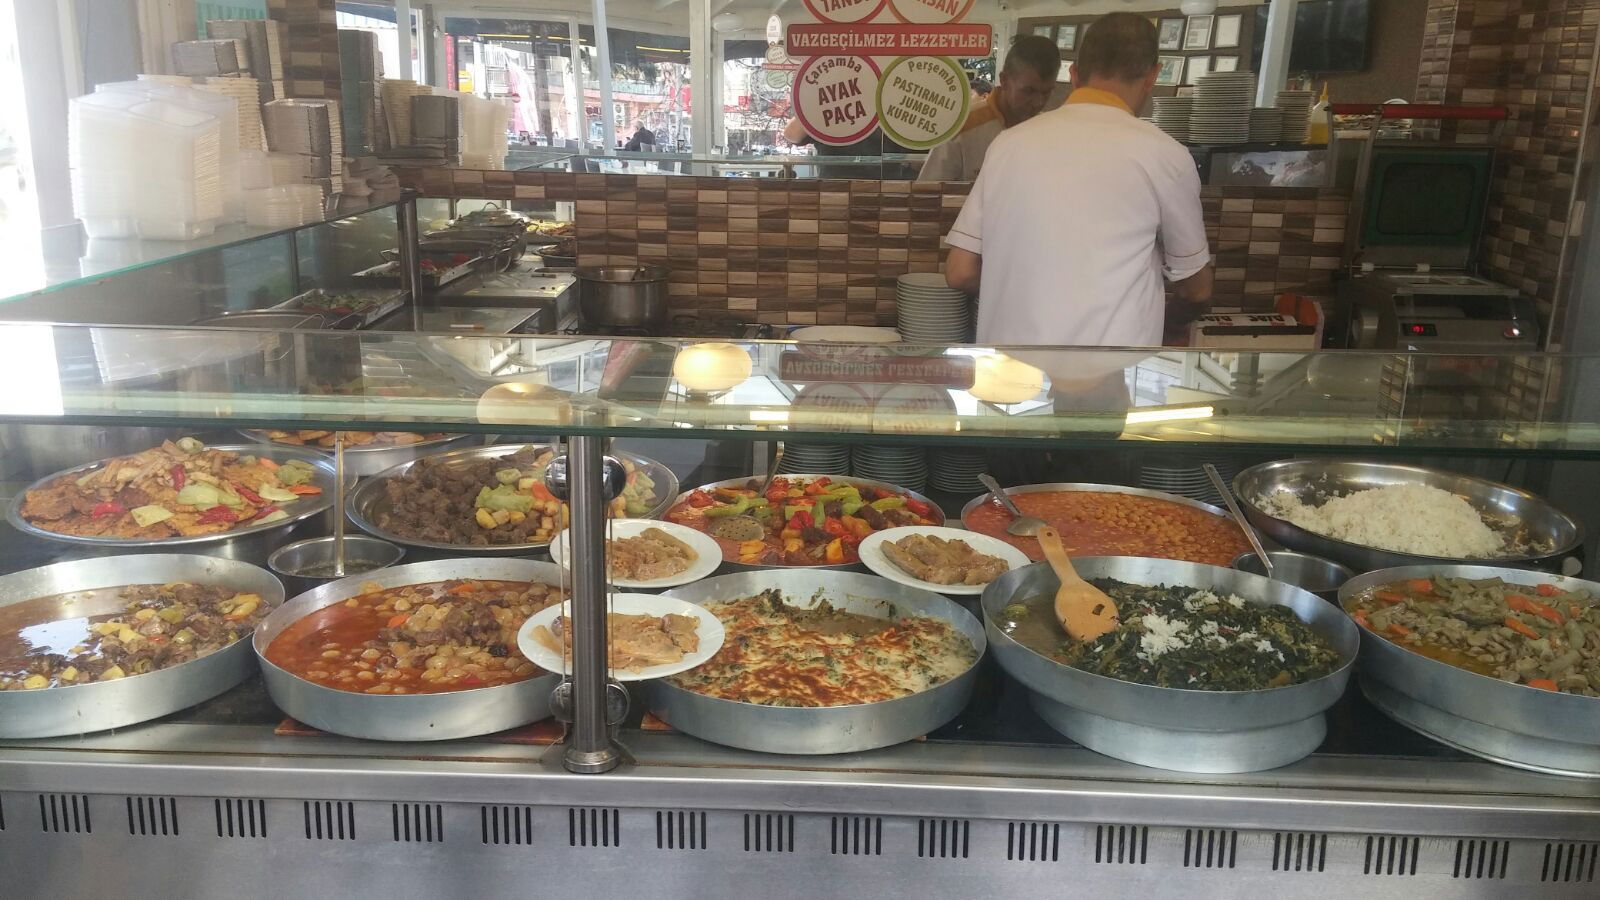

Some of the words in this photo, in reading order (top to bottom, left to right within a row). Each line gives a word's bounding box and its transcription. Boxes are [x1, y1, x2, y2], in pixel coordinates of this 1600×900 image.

[791, 30, 895, 50] VAZGEÇİLMEZ
[901, 33, 988, 48] LEZZETLER
[805, 57, 862, 85] Çarşamba
[907, 61, 957, 92] Perşembe
[818, 77, 862, 106] AYAK
[892, 76, 957, 111] PASTIRMALI
[822, 100, 867, 127] PAÇA
[886, 104, 917, 125] KURU
[917, 117, 939, 135] FAS.
[899, 95, 937, 118] JUMBO
